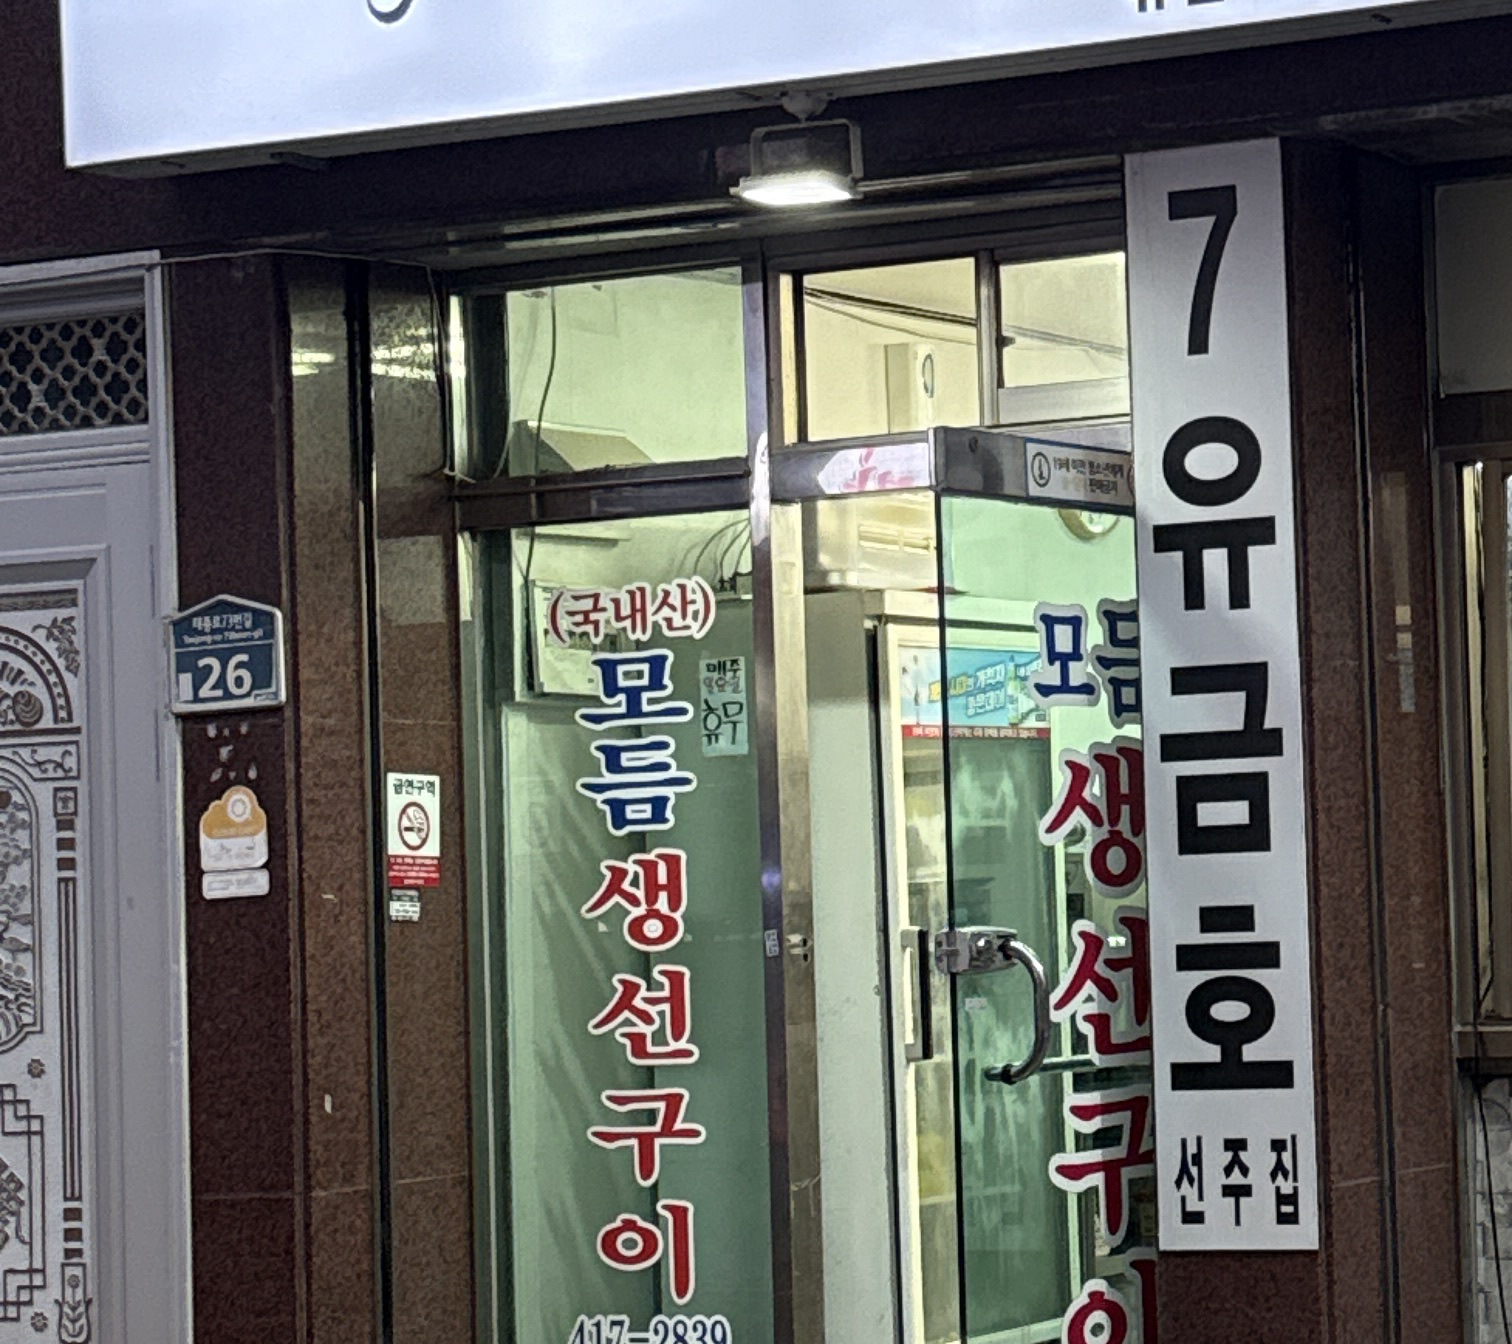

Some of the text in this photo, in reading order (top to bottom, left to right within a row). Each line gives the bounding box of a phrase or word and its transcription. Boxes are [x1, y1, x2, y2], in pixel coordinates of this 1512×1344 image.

[550, 579, 713, 643] (국내산)
[196, 652, 253, 699] 26
[705, 658, 743, 678] 매주
[701, 697, 744, 747] 휴무
[392, 777, 436, 798] 금연구역
[578, 652, 703, 1301] 모듬 생선구이
[1173, 1133, 1300, 1227] 선주집
